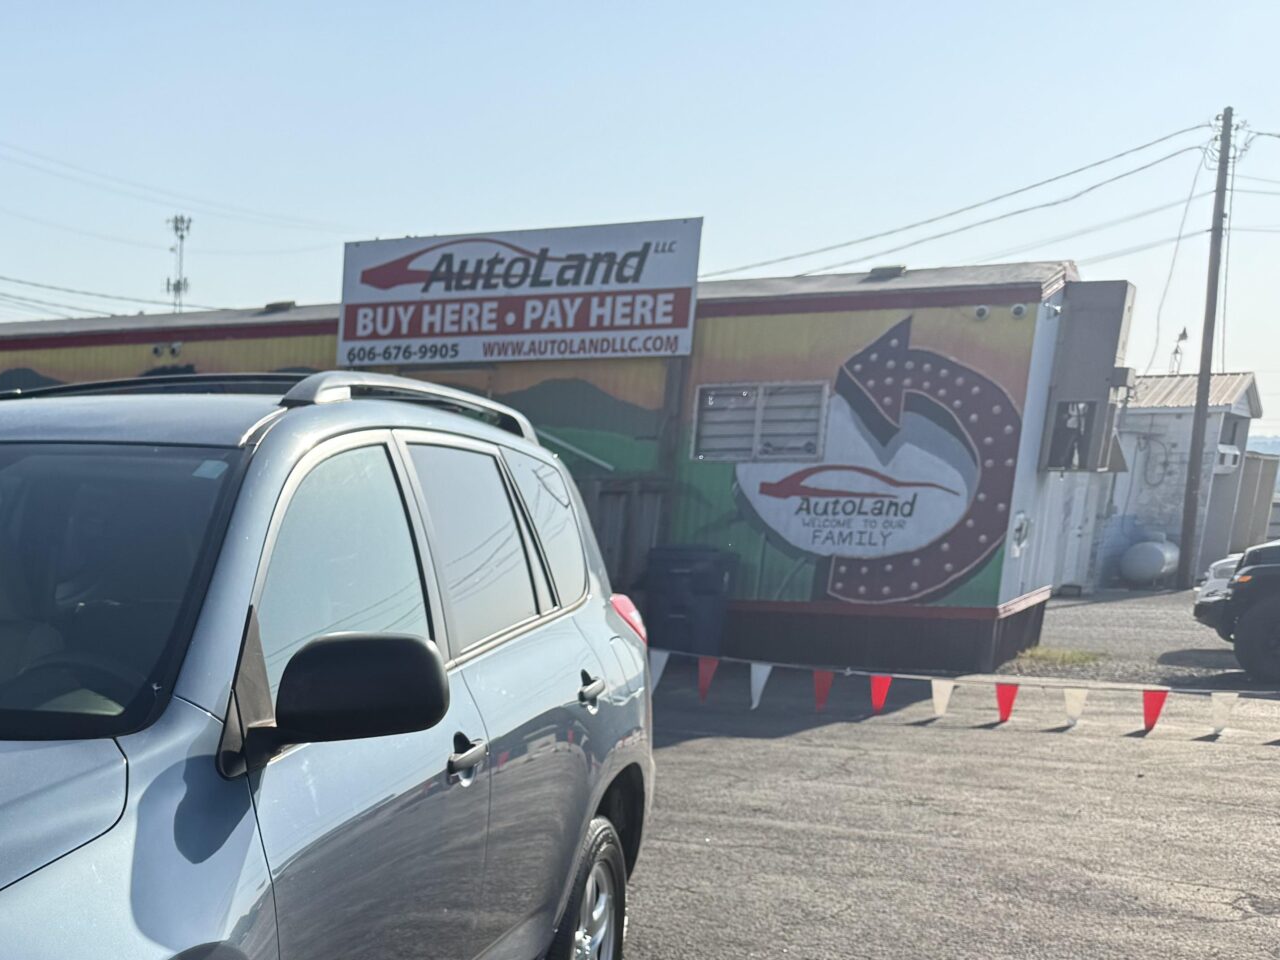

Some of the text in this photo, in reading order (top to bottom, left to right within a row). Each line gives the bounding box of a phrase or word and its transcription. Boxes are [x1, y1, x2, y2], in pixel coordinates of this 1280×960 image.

[421, 241, 677, 293] AutoLand LLC
[356, 293, 675, 337] BUY HERE PAY HERE
[347, 335, 679, 363] 606-676-9905 WWW.AUTOLANDLLC.COM
[794, 492, 918, 518] AutoLand
[802, 518, 907, 530] WELCOME TO OUR
[811, 529, 893, 547] FAMILY
